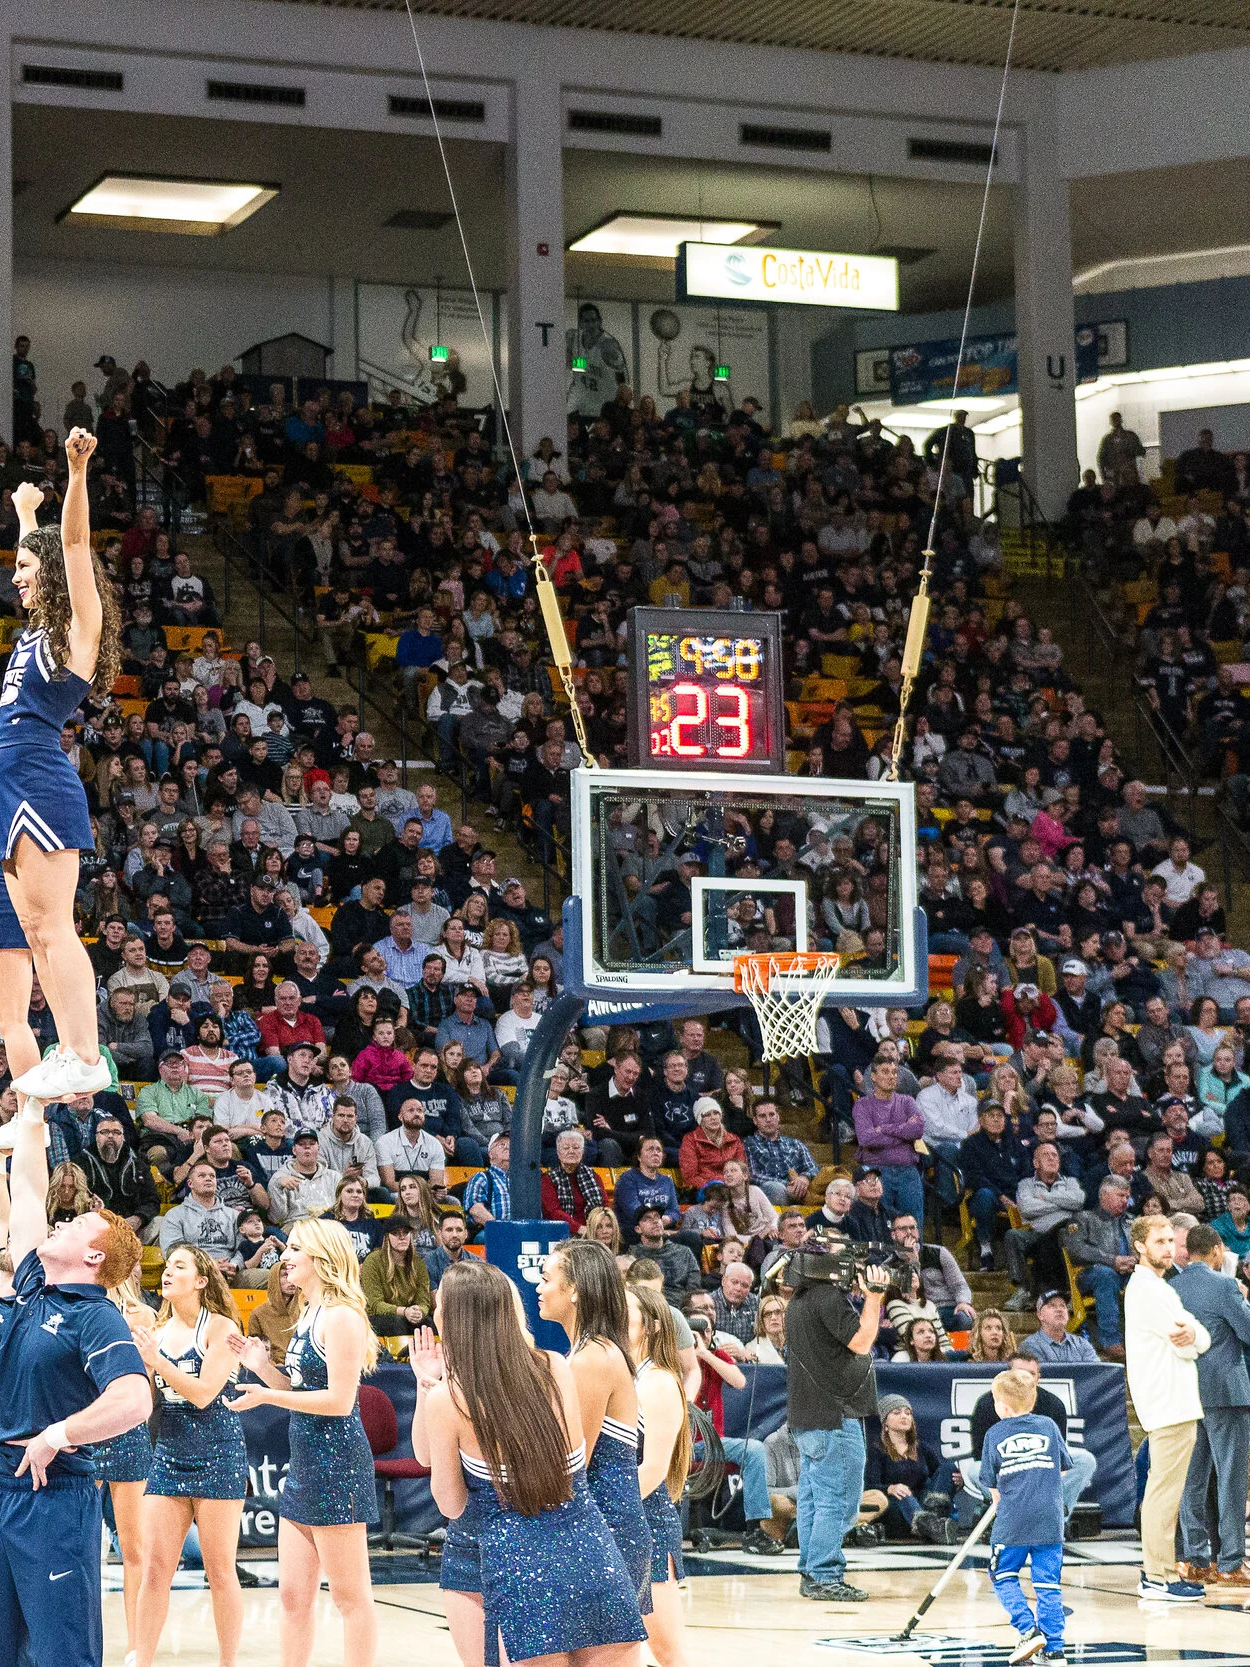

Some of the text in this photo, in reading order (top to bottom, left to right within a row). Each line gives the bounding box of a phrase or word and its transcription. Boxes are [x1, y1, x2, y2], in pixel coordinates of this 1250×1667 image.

[535, 322, 554, 347] T
[1046, 355, 1065, 380] U
[670, 684, 750, 757] 23
[595, 974, 628, 984] SPALDING
[240, 1509, 275, 1535] re
